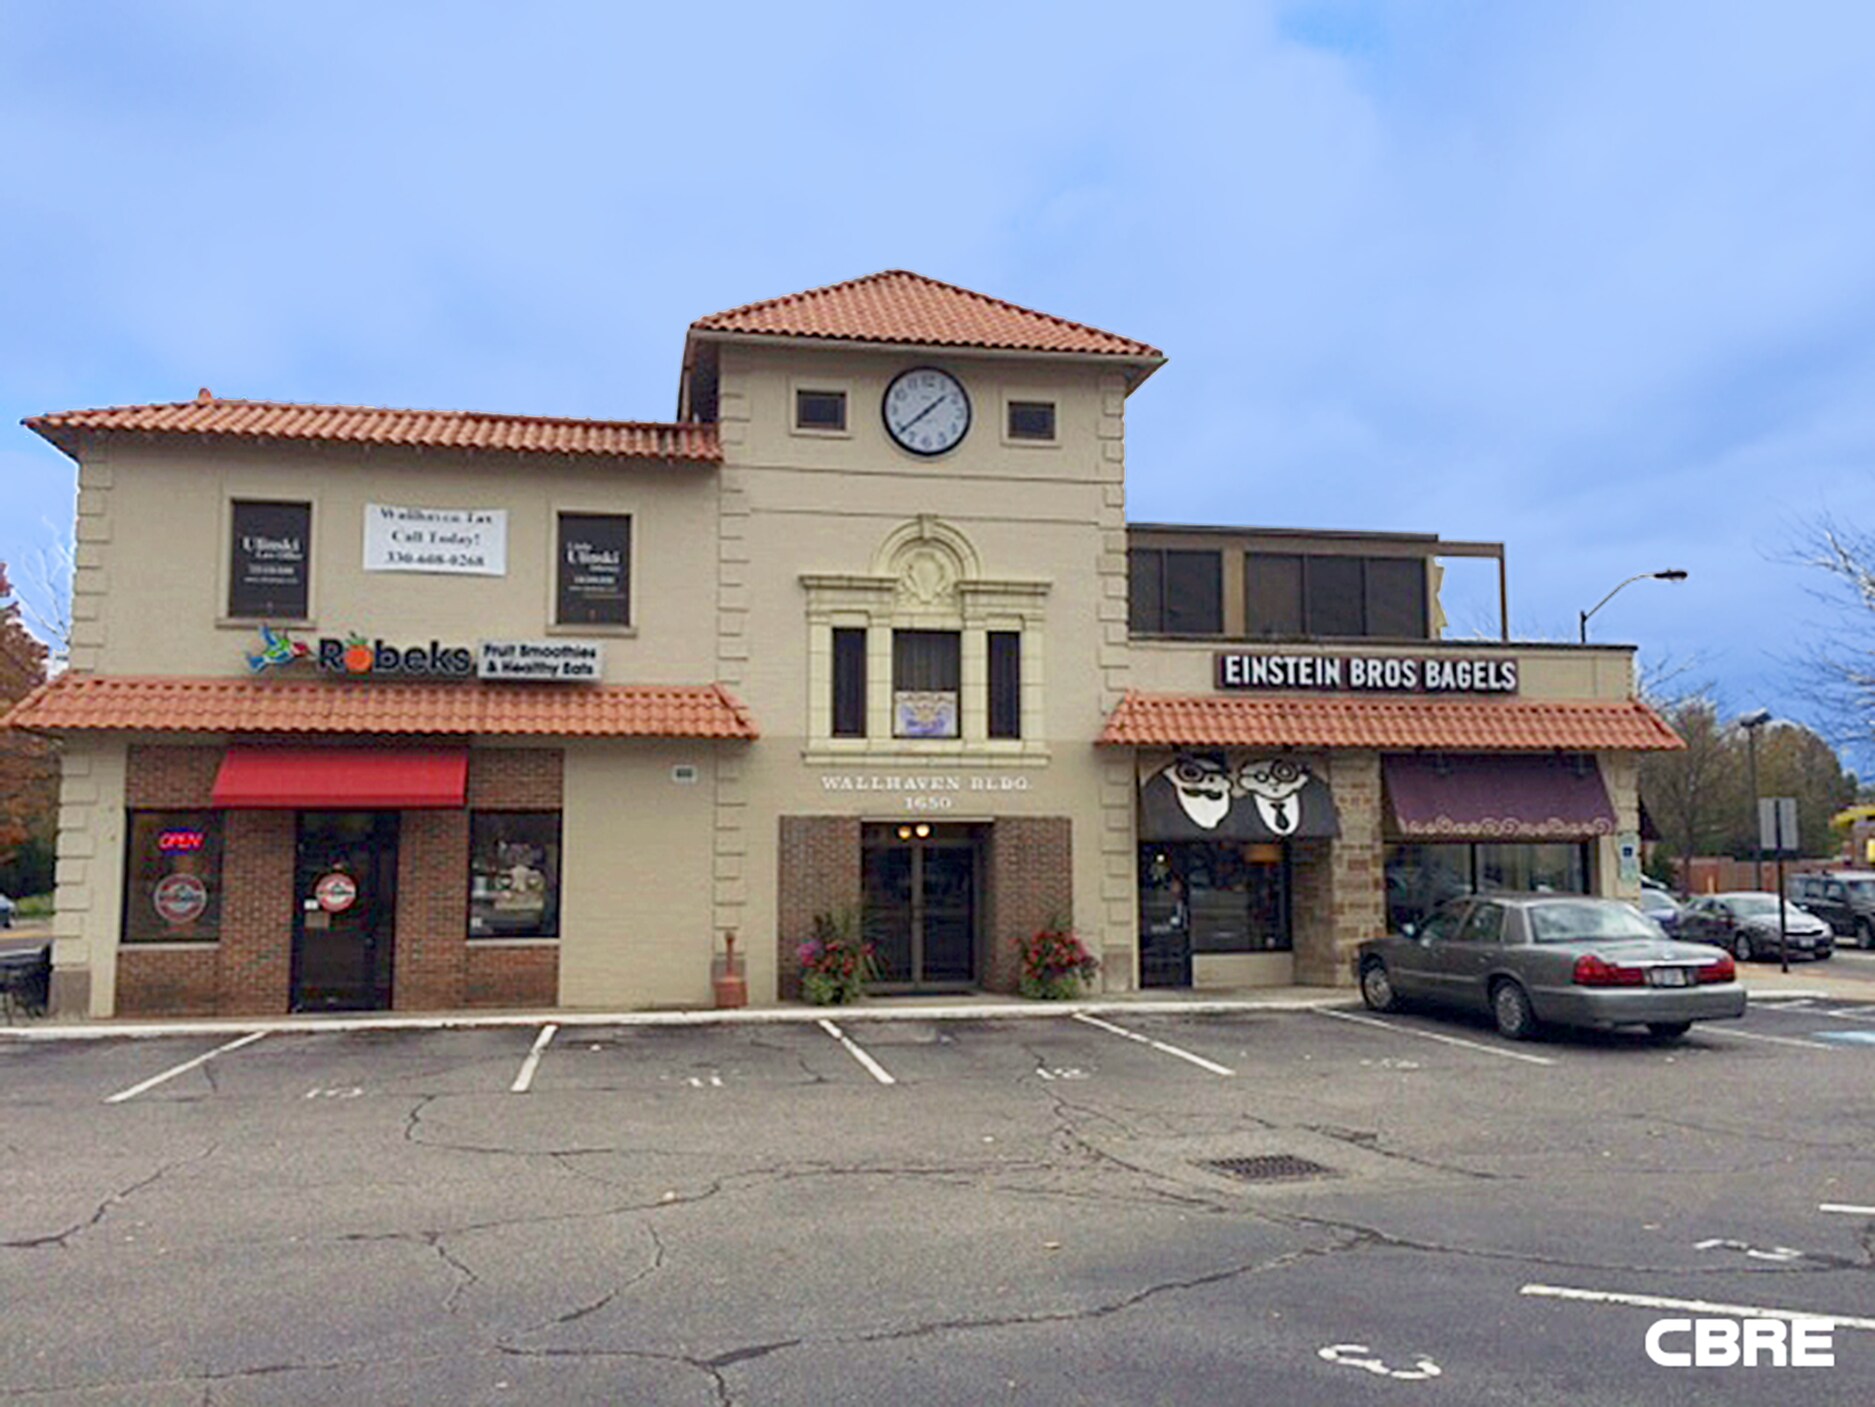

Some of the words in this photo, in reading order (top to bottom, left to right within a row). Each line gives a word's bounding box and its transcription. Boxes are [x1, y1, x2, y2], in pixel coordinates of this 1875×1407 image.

[391, 531, 423, 543] Call
[318, 635, 472, 674] Robeks
[483, 643, 516, 657] Fruit
[519, 644, 597, 659] Smoothies
[486, 659, 497, 673] &
[501, 661, 560, 677] Healthy
[563, 662, 594, 675] Eats
[1225, 655, 1341, 685] EINSTEIN
[1350, 658, 1418, 688] BROS
[1424, 660, 1517, 690] BAGELS
[821, 775, 961, 791] WALLHAVEN
[904, 796, 952, 810] 1650
[159, 831, 205, 850] OPEN
